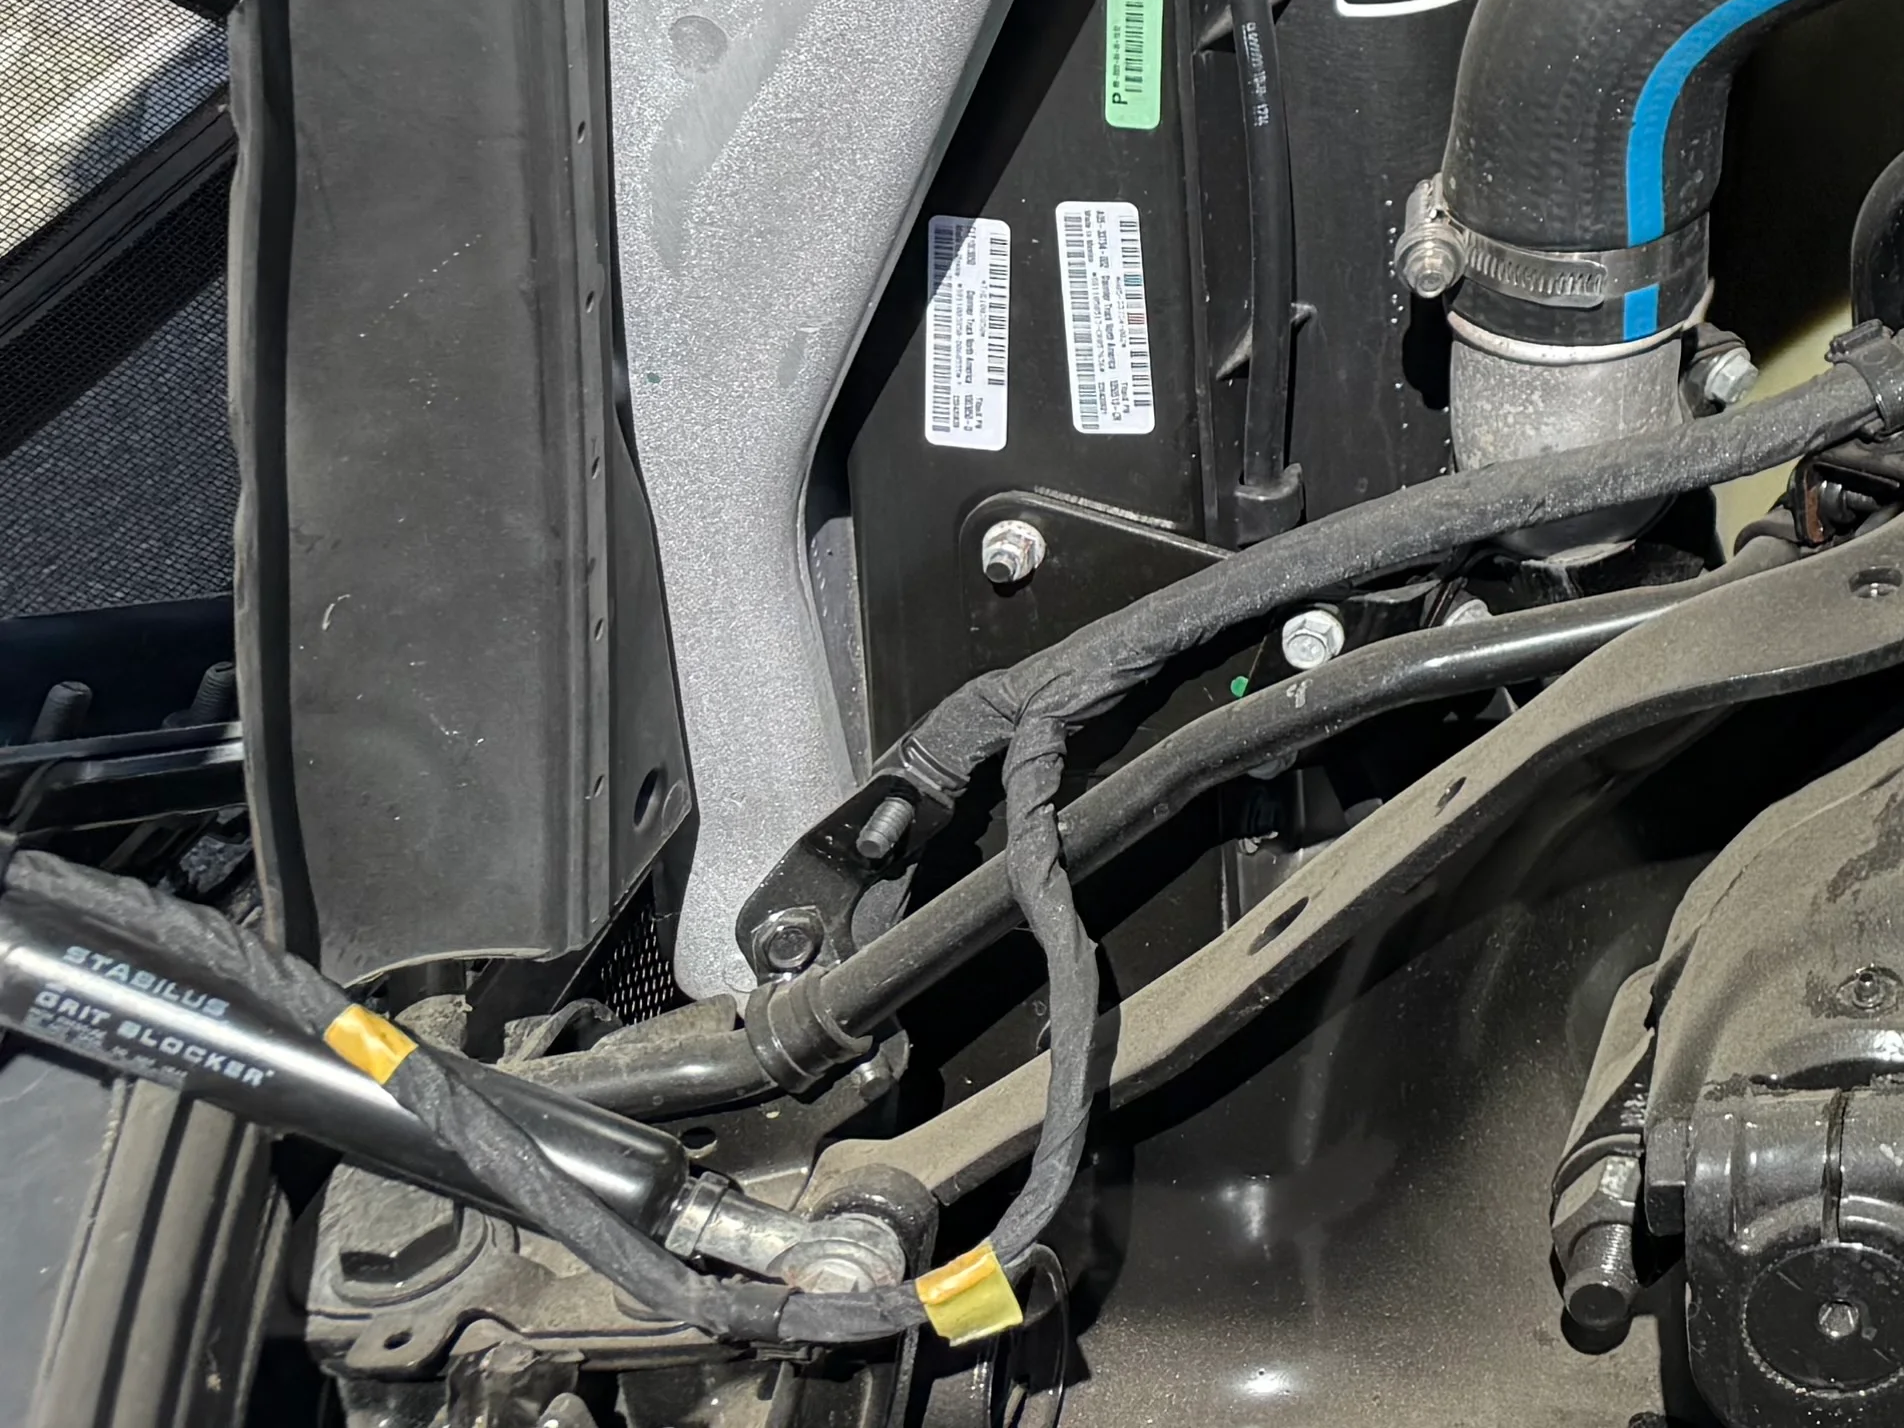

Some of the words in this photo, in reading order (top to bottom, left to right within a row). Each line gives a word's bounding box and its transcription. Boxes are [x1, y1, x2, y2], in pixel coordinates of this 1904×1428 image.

[1112, 92, 1128, 105] P
[62, 946, 231, 1019] STABILUS
[35, 990, 113, 1032] GRIT
[117, 1020, 268, 1087] BLOCKER
